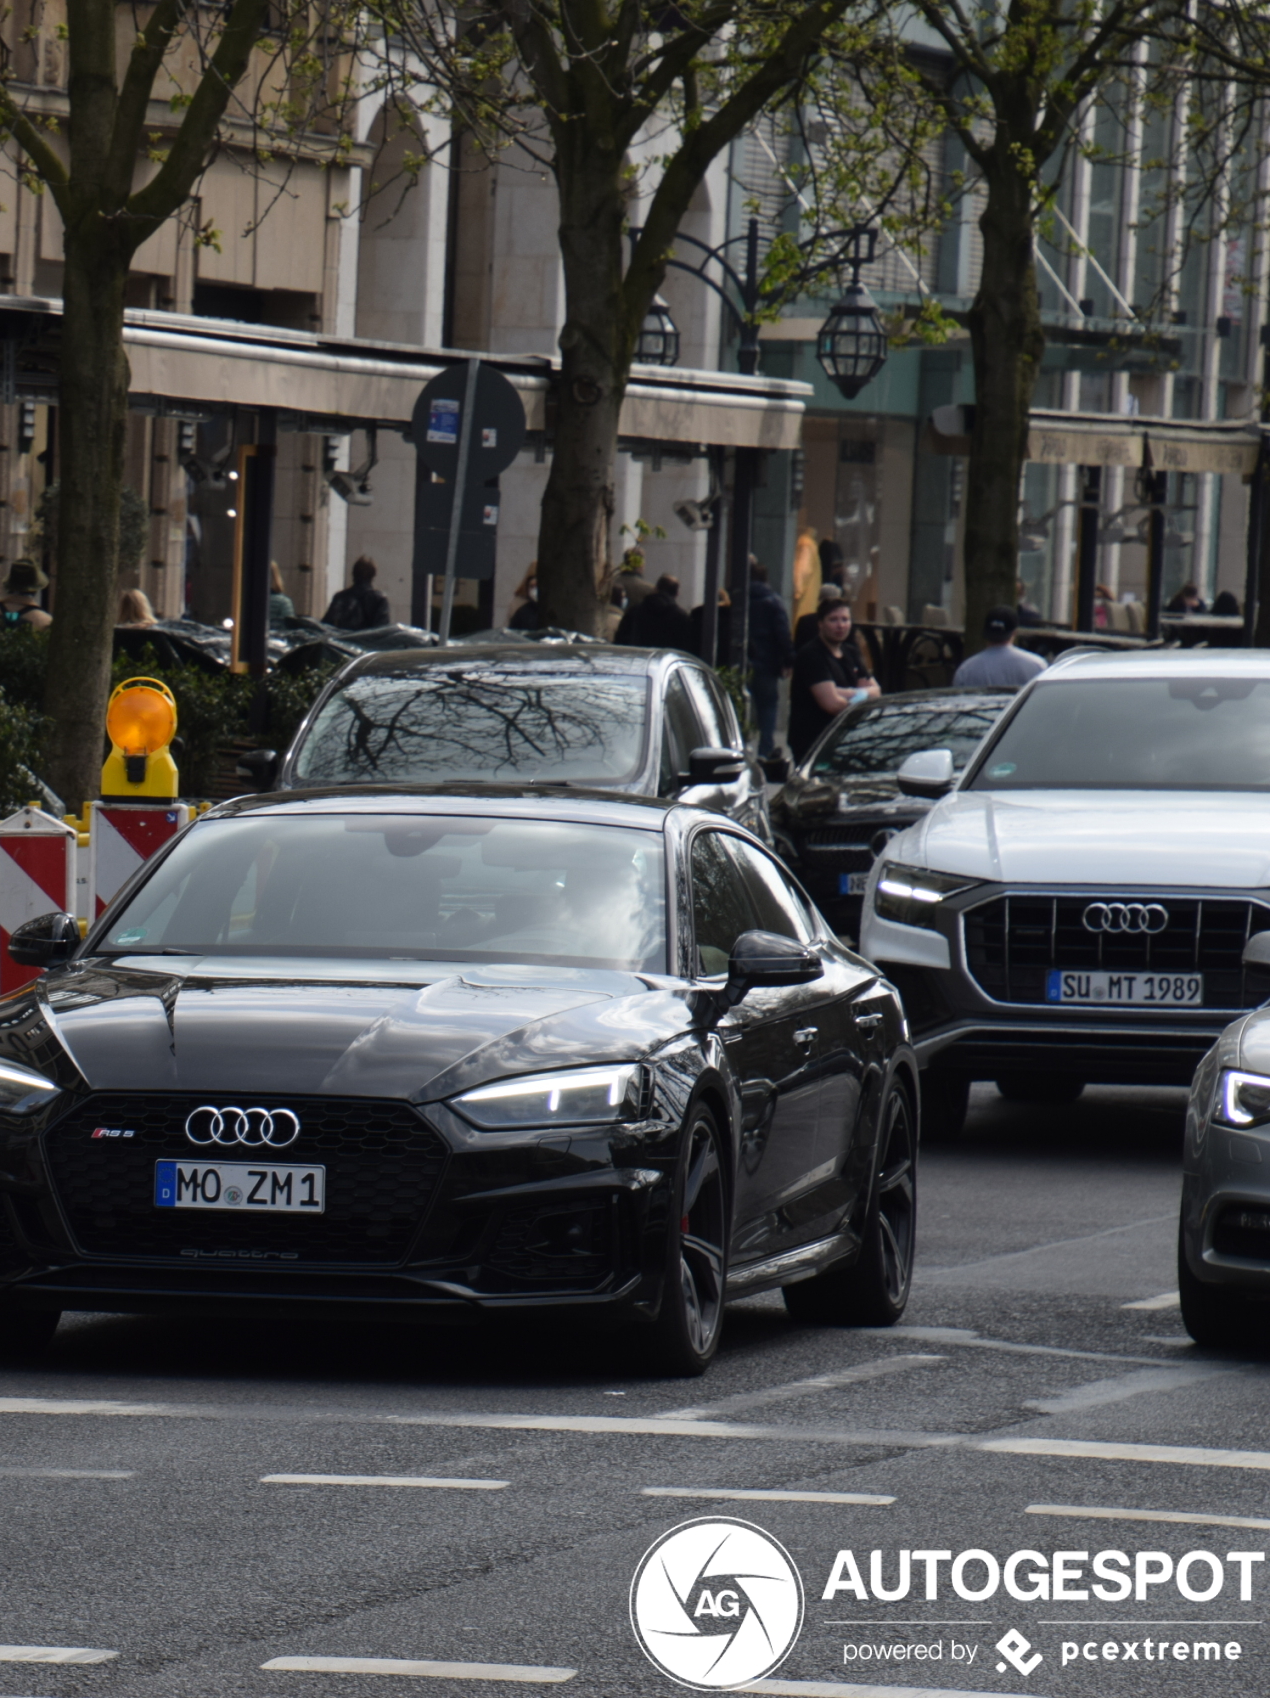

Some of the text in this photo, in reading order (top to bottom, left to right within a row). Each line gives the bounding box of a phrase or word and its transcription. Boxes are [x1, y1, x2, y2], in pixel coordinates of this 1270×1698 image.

[1063, 974, 1091, 999] SU
[1108, 975, 1137, 1000] MT
[1143, 976, 1200, 1001] 1989
[161, 1188, 171, 1199] D
[176, 1167, 222, 1204] MO
[180, 1248, 299, 1260] quattro
